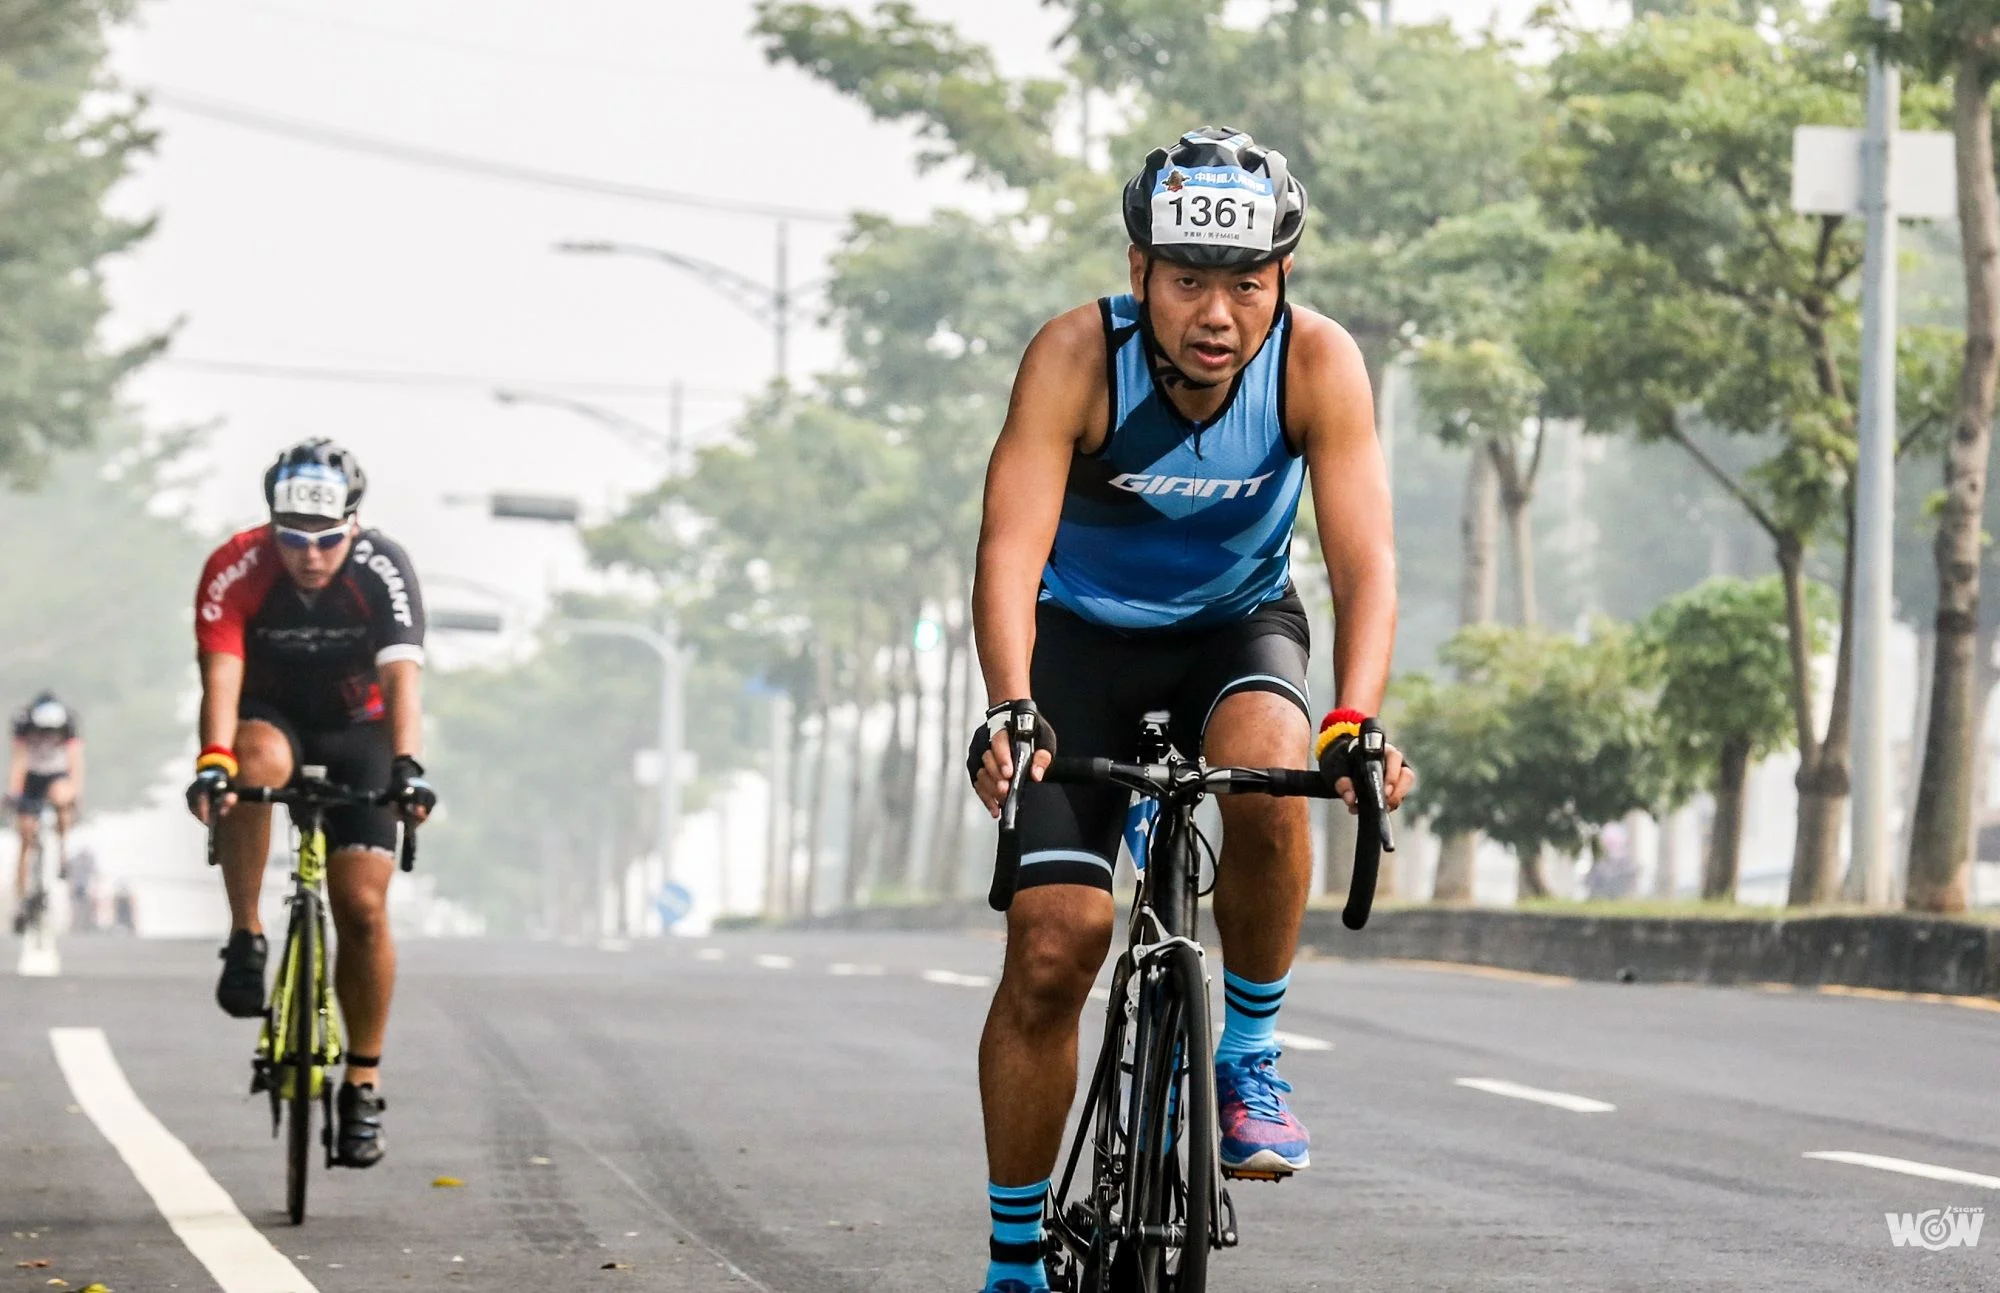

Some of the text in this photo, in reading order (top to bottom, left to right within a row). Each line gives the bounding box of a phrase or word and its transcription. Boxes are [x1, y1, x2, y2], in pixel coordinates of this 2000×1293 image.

[1169, 196, 1255, 229] 1361
[1108, 471, 1275, 499] GIANT
[368, 555, 412, 628] GIANT
